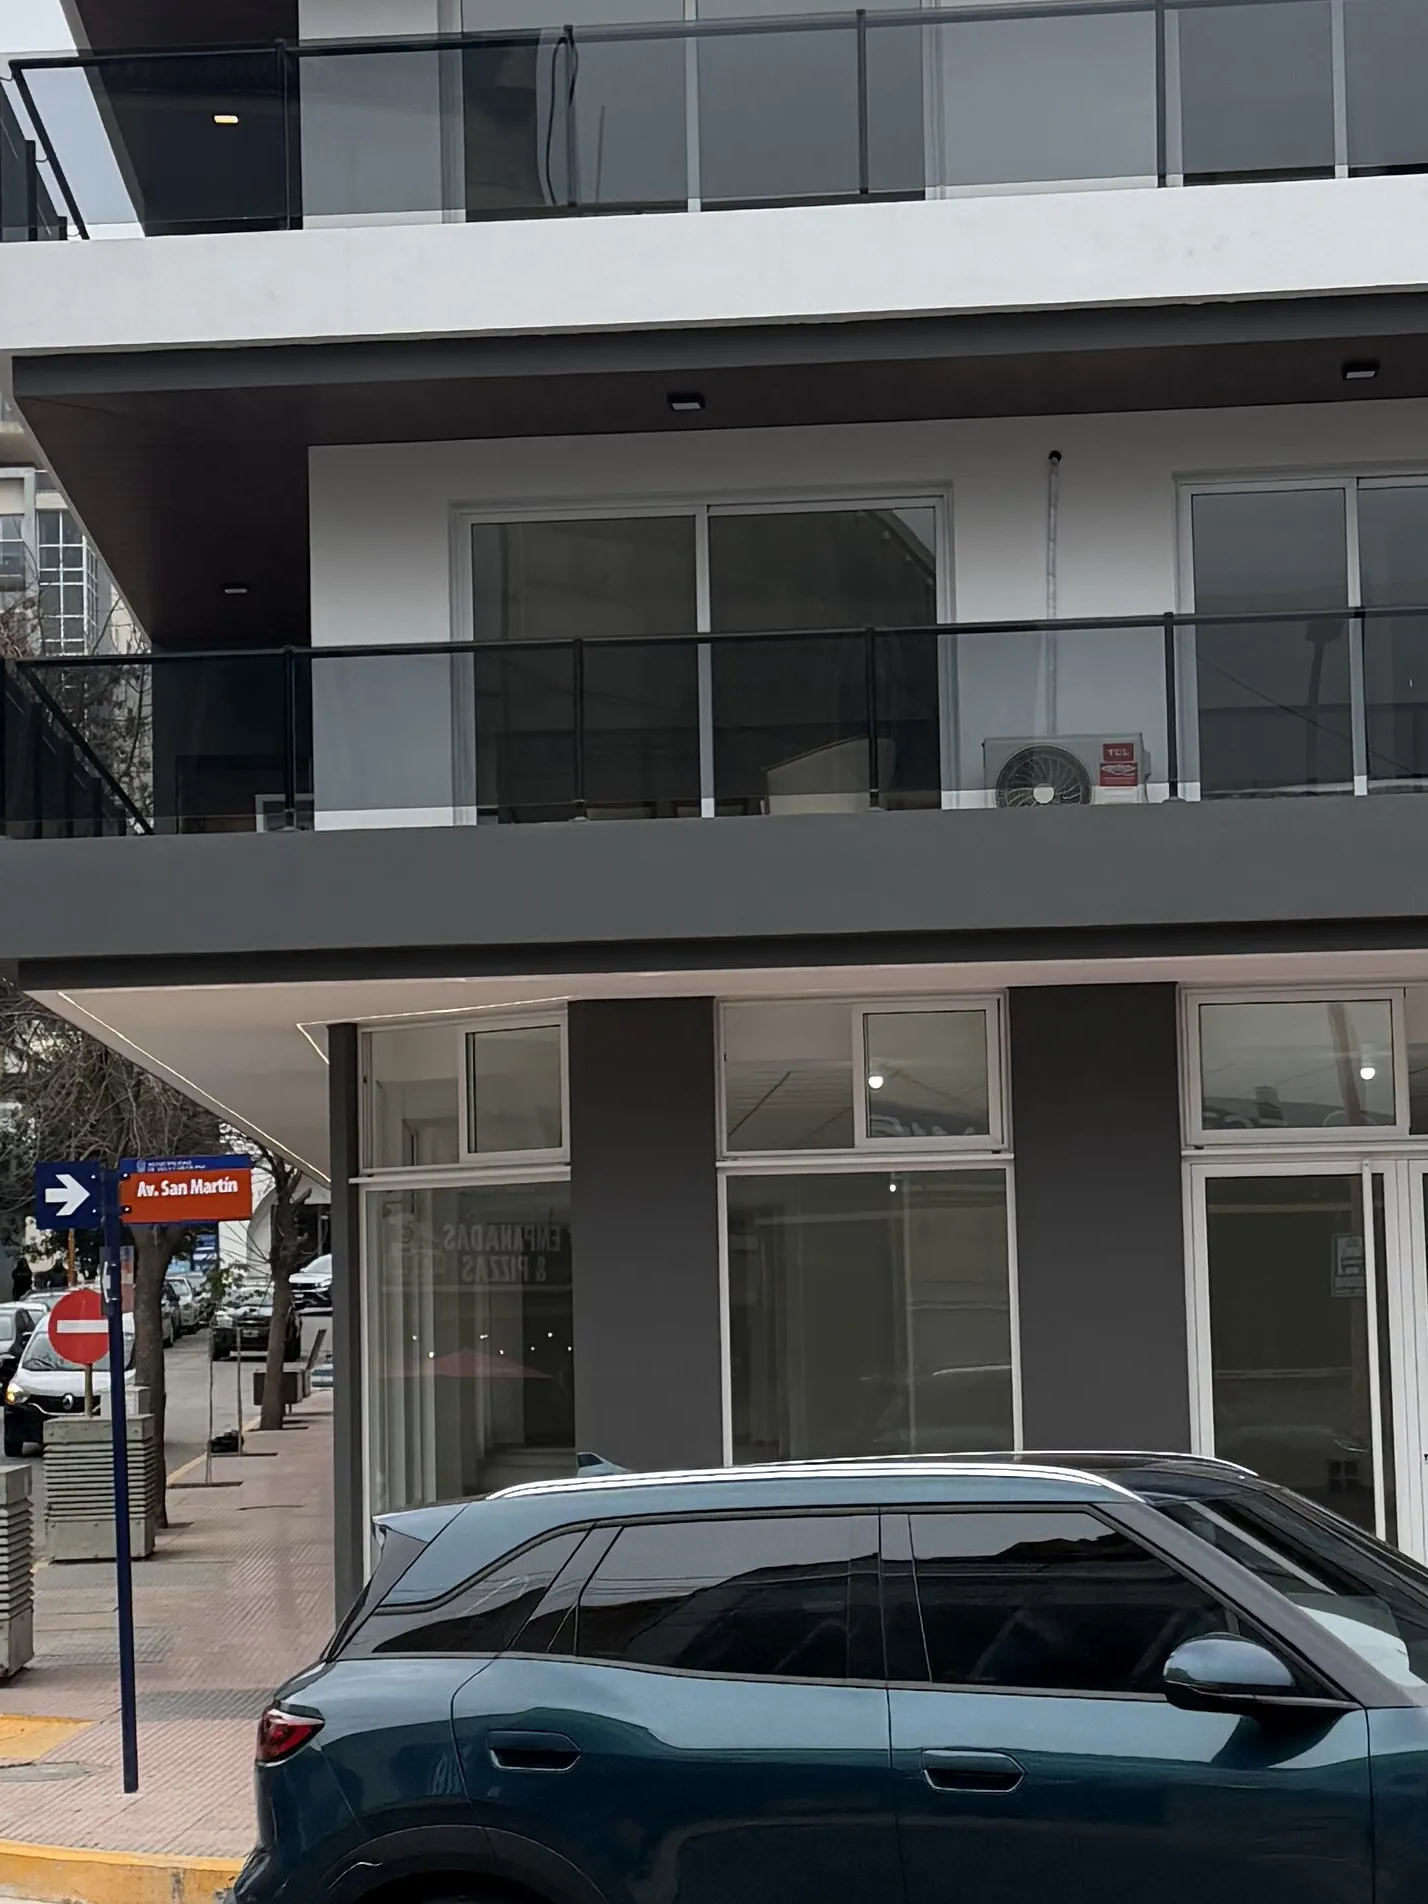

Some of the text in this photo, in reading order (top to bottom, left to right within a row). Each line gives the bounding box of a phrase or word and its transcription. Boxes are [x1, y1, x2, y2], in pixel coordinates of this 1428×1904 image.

[1106, 748, 1129, 757] TCL
[137, 1176, 239, 1197] Av. San Martín
